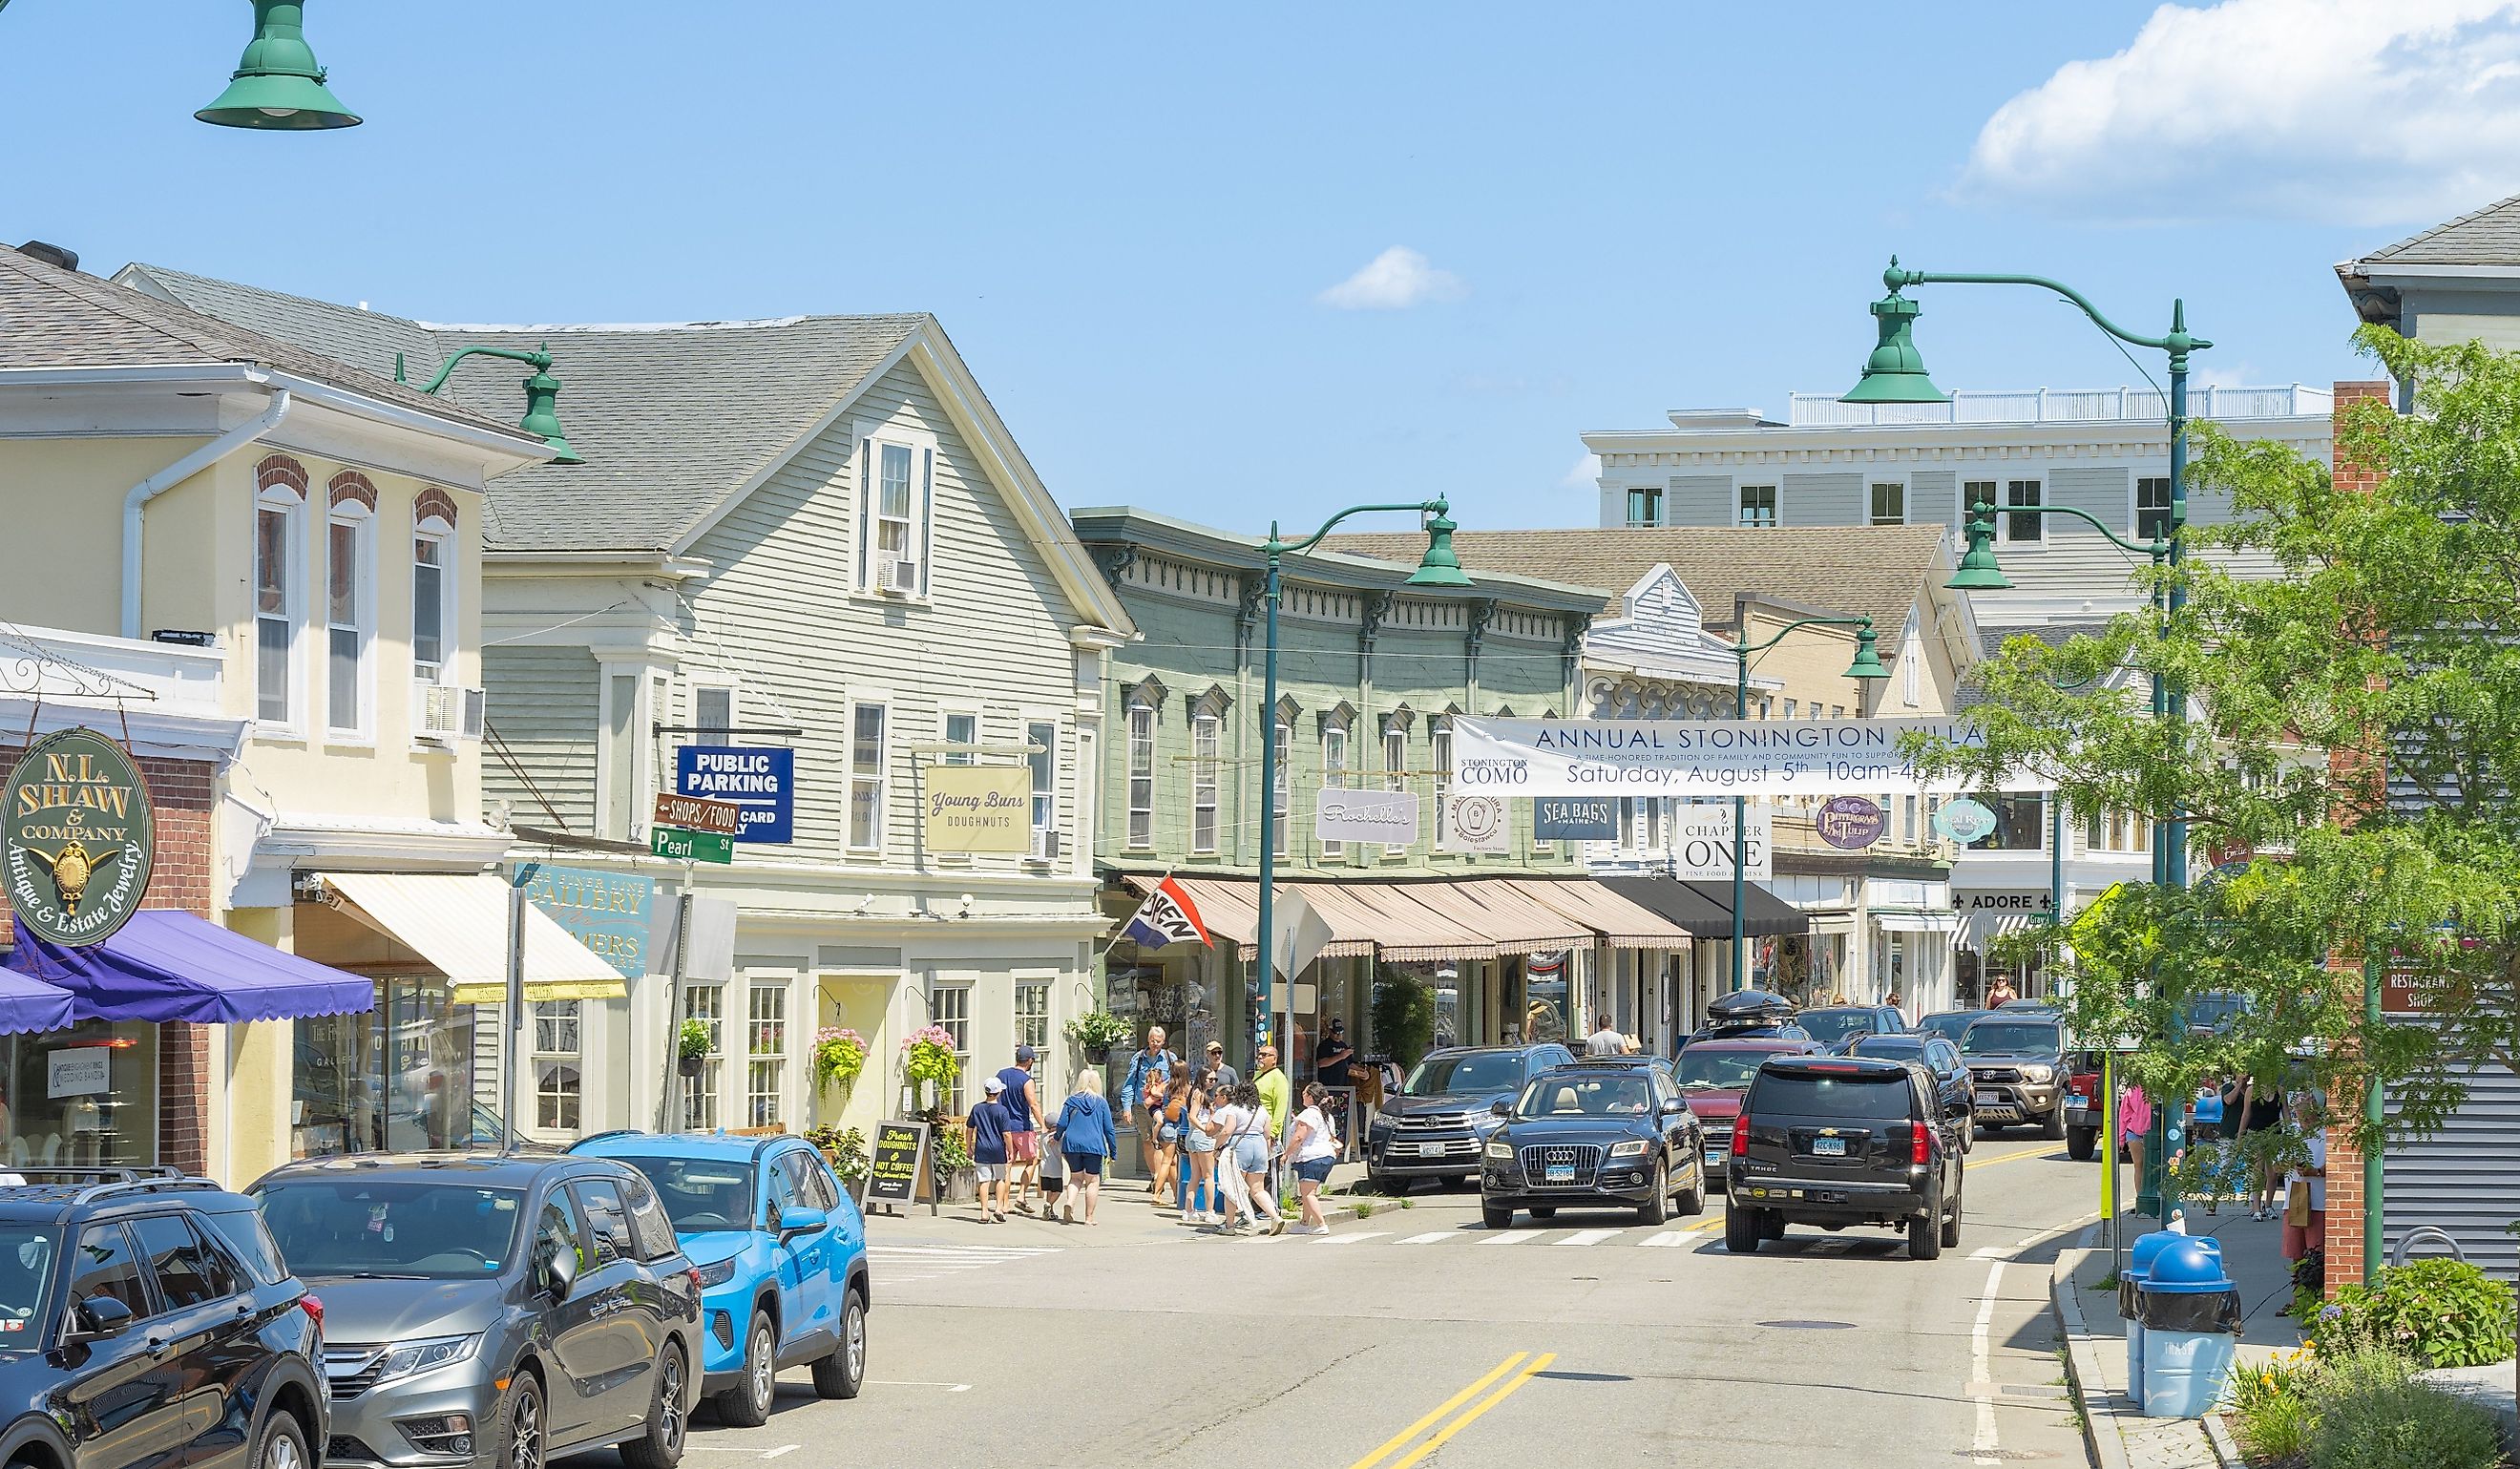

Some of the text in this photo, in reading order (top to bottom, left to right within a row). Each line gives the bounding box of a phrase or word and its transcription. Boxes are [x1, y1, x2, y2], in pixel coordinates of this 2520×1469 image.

[1535, 729, 1664, 748] ANNUAL
[1679, 727, 1884, 748] STONINGTON
[44, 753, 109, 783] N.L.
[697, 754, 769, 773] PUBLIC
[687, 774, 778, 793] PARKING
[1461, 766, 1527, 784] COMO
[1567, 765, 1678, 787] Saturday,
[1688, 765, 1769, 787] August
[1782, 761, 1809, 781] 5th
[18, 784, 132, 820] SHAW
[932, 791, 1024, 817] Young Buns
[66, 808, 85, 826] &
[740, 811, 775, 824] CARD
[947, 816, 1010, 828] DOUGHNUTS
[1324, 804, 1411, 825] Rochelle's
[1544, 803, 1607, 824] SEA BAGS
[22, 826, 128, 841] COMPANY
[657, 831, 729, 856] Pearl St
[1686, 841, 1763, 867] ONE
[9, 837, 143, 934] Antique & Estate Jewelry
[524, 870, 551, 883] THE
[558, 874, 603, 888] FINER
[522, 882, 645, 915] GALLERY
[1971, 895, 2033, 909] ADORE
[1140, 892, 1197, 937] OPEN
[567, 932, 639, 958] MERS
[886, 1129, 914, 1141] Fresh
[878, 1140, 917, 1150] DOUGHNUTS
[890, 1152, 899, 1162] &
[875, 1162, 914, 1172] HOT COFFEE
[2165, 1341, 2194, 1355] TRASH
